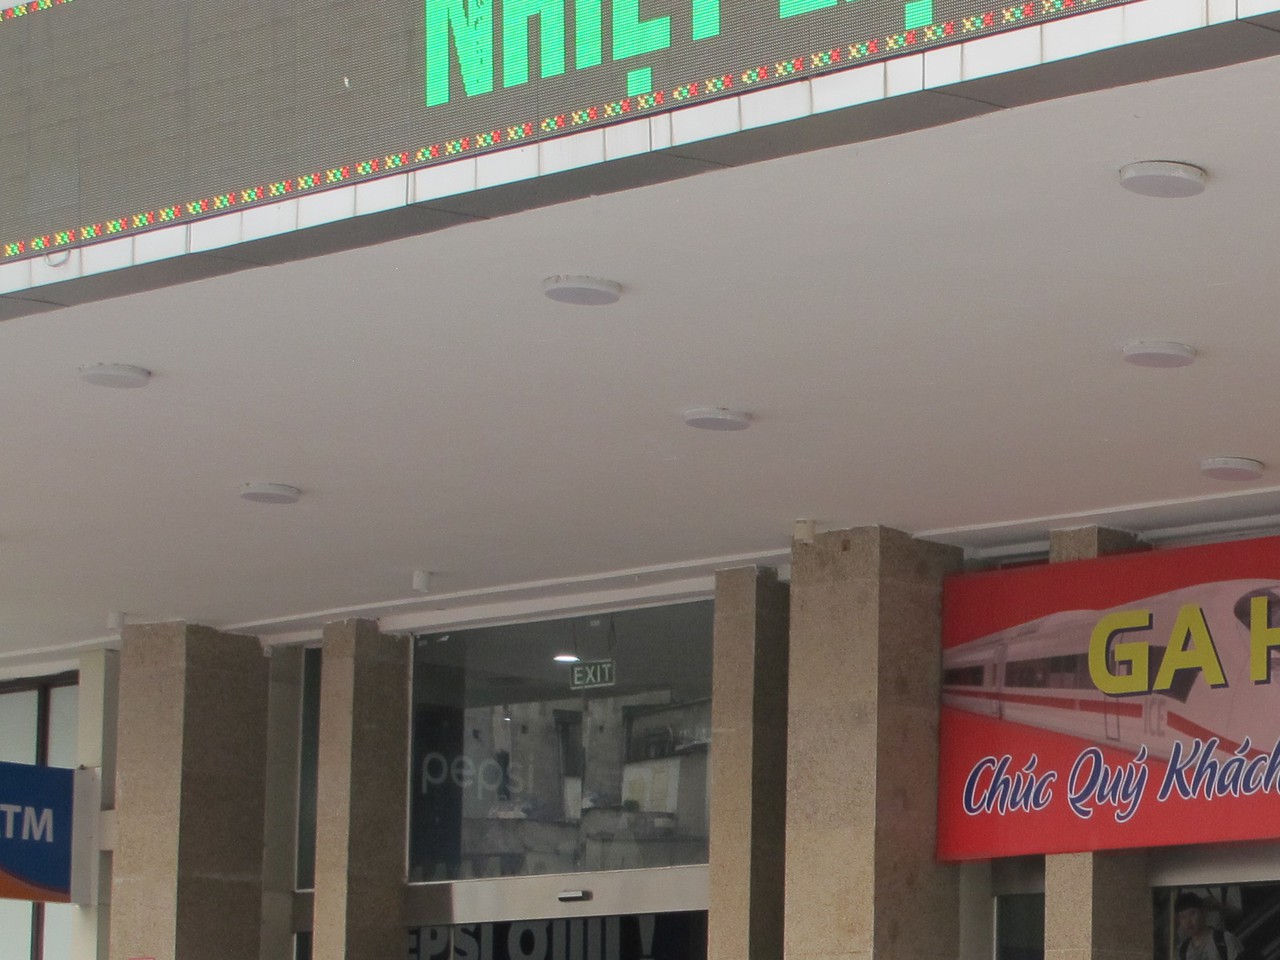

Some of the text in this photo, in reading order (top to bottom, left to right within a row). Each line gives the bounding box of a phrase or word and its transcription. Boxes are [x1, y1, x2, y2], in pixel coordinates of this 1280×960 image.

[573, 663, 612, 686] EXIT
[1087, 603, 1228, 695] GA
[421, 751, 535, 802] pepsi
[963, 753, 1057, 816] Chúc
[1067, 744, 1148, 823] Quý
[0, 804, 54, 843] TM
